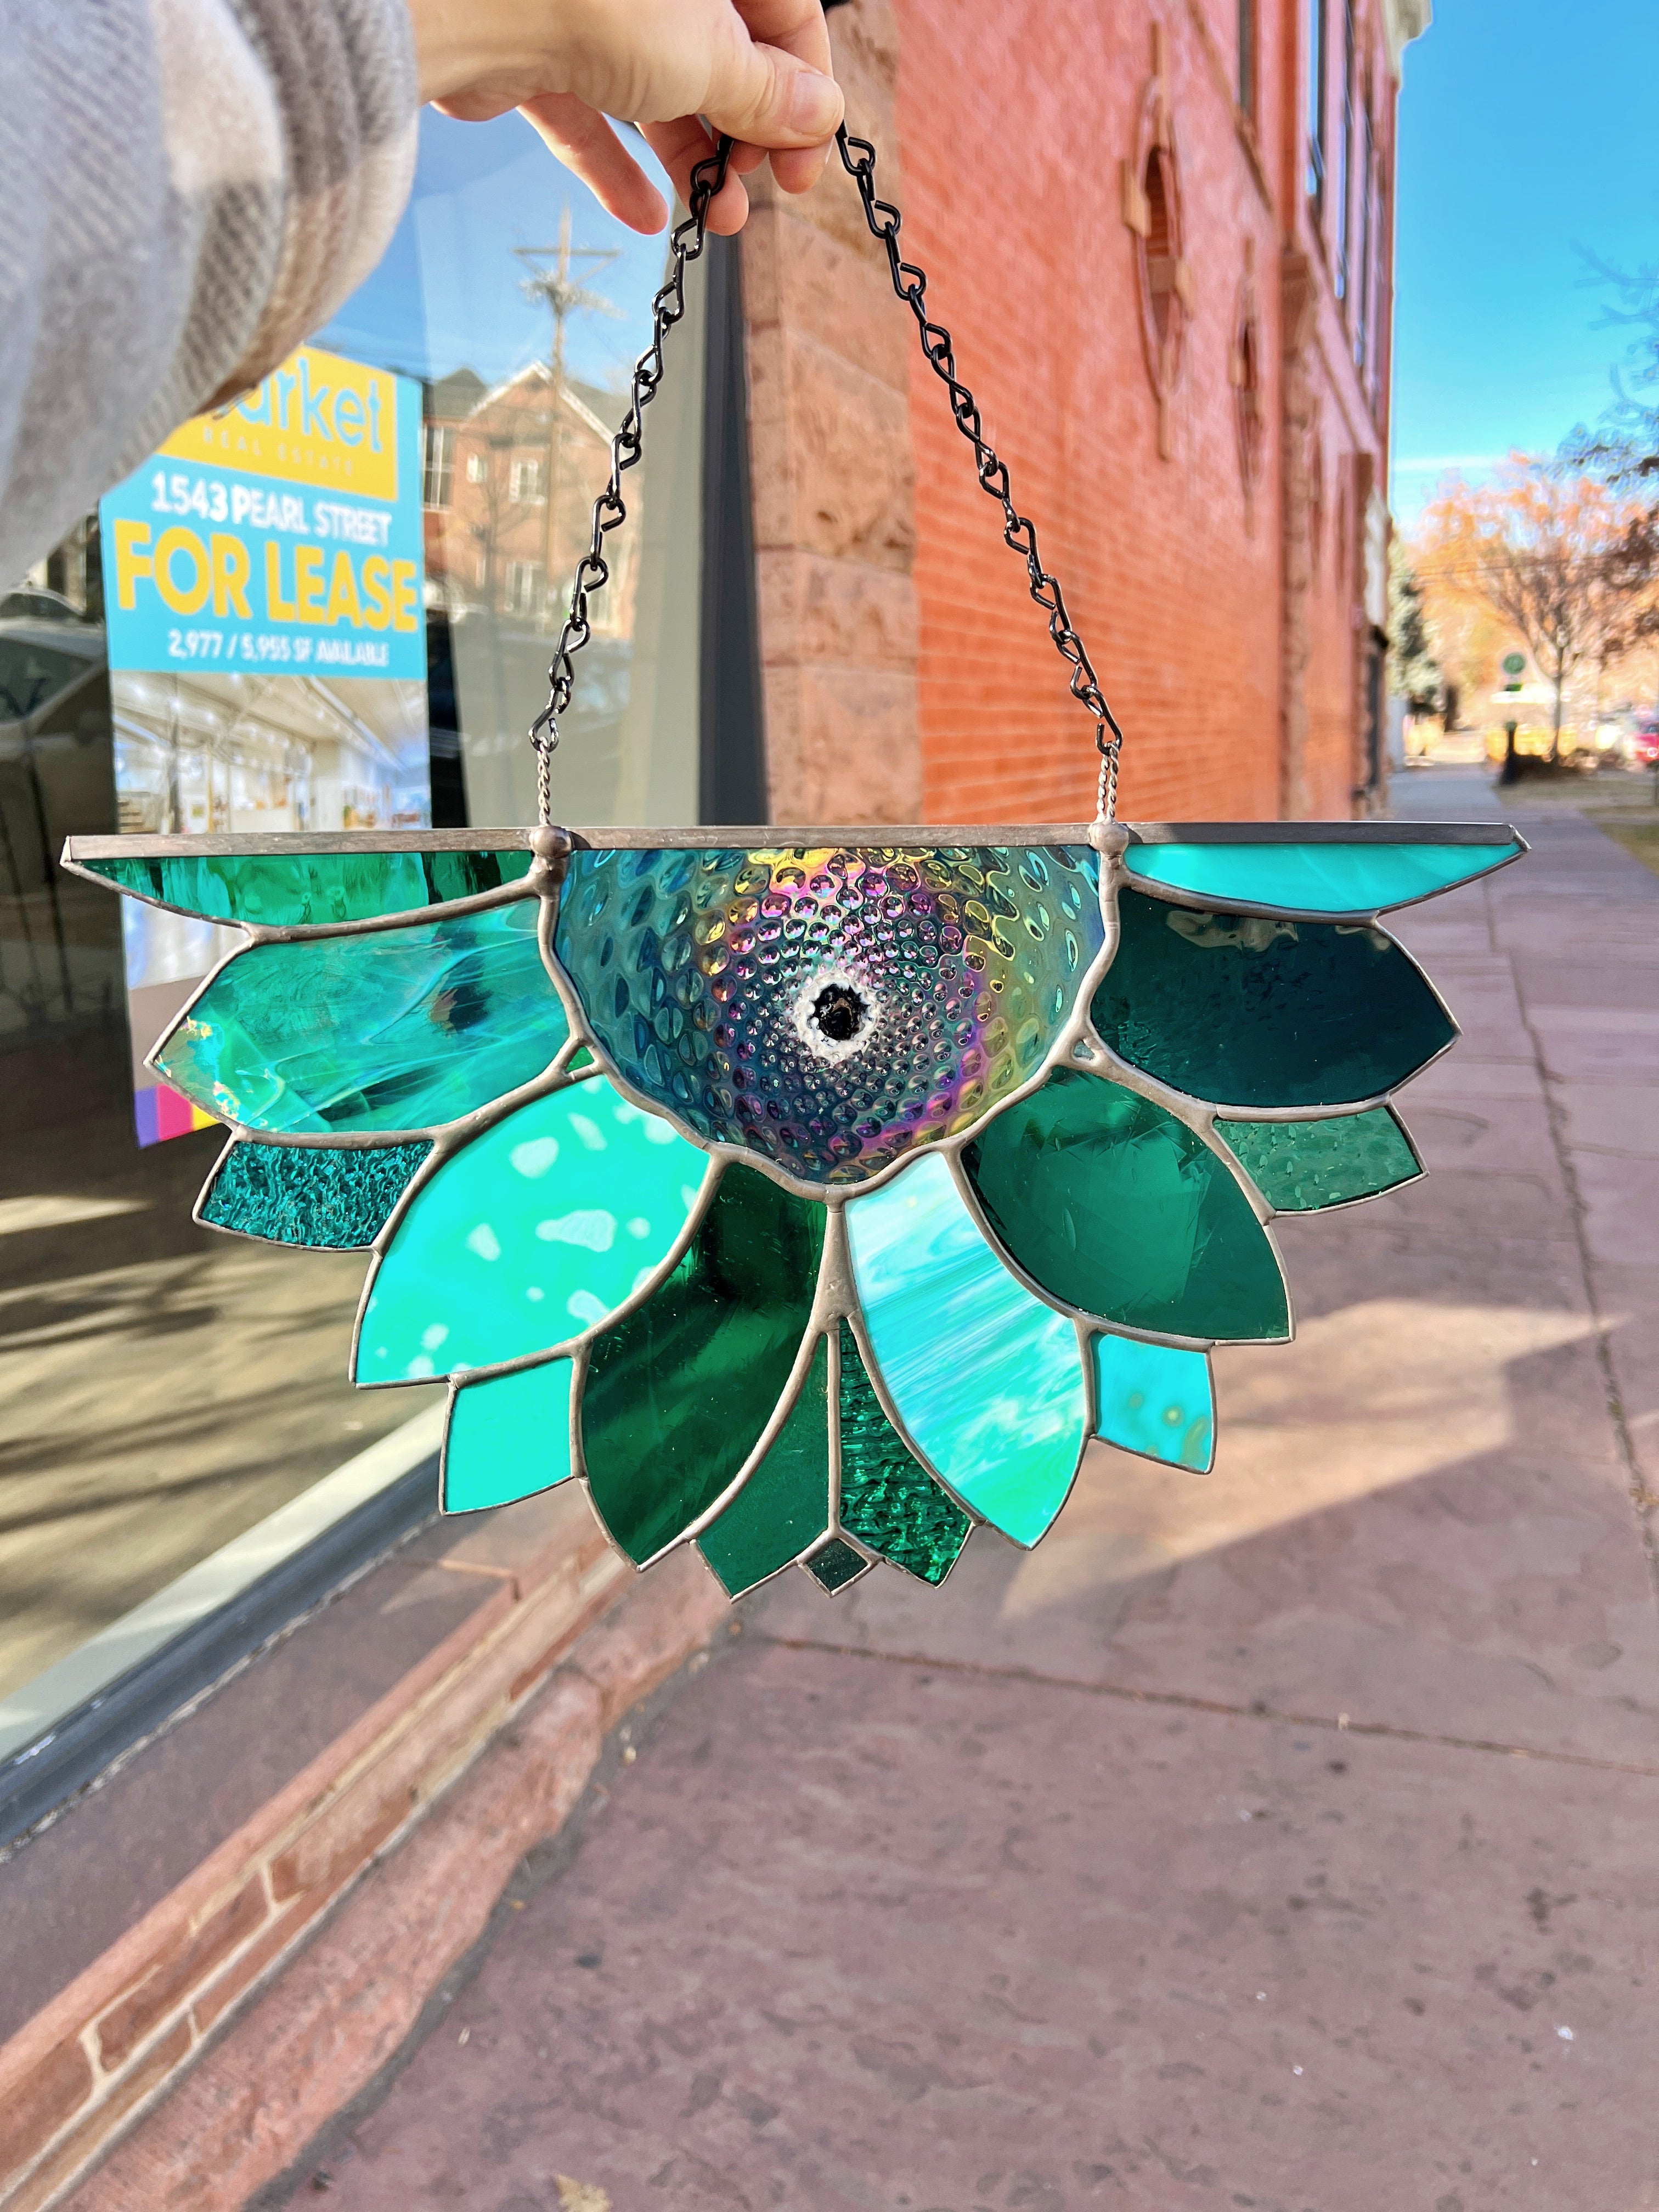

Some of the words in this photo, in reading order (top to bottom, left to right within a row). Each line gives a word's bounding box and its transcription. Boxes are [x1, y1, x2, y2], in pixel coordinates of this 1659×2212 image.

[202, 425, 262, 456] REAL
[217, 357, 383, 453] arket
[151, 471, 228, 522] 1543
[230, 484, 309, 535] PEARL
[313, 500, 393, 547] STREET
[114, 518, 253, 619] FOR
[265, 540, 418, 632] LEASE
[168, 629, 223, 659] 2,977
